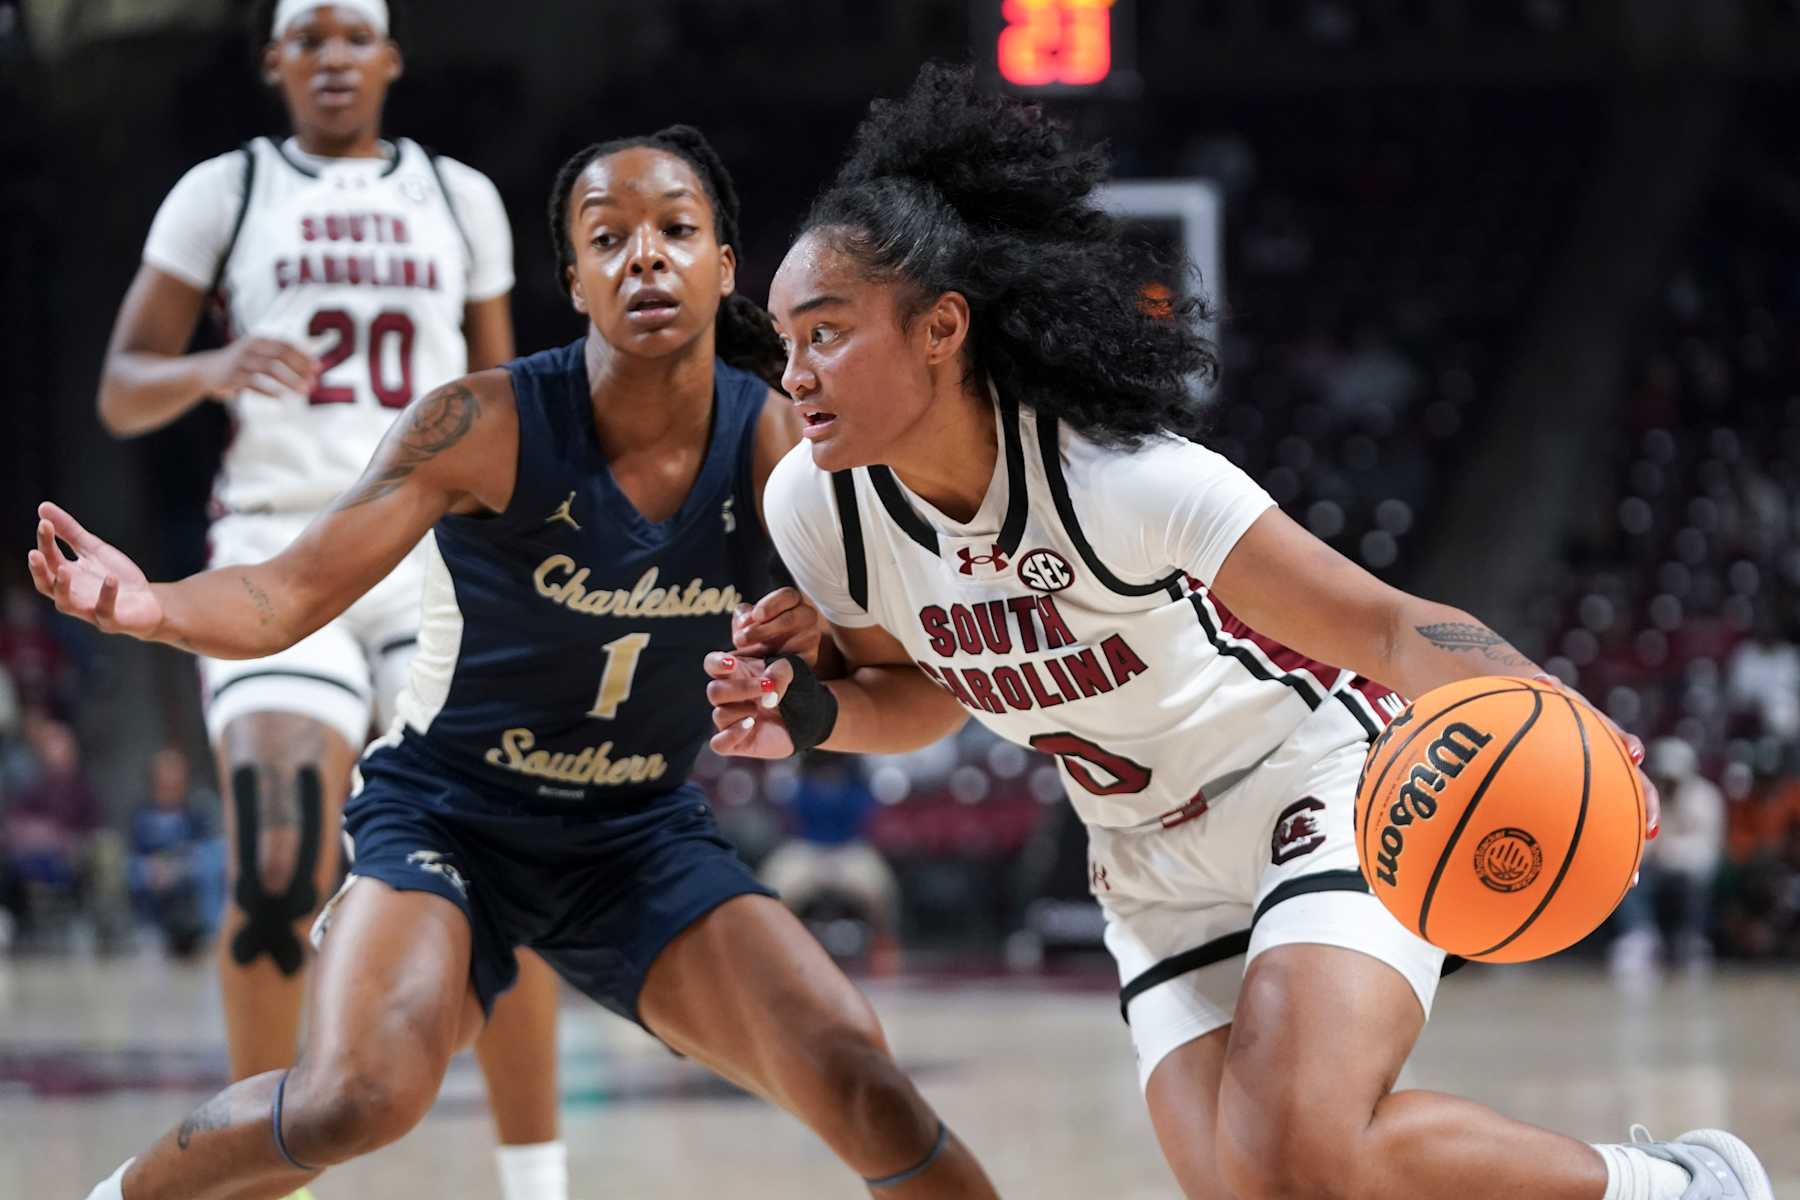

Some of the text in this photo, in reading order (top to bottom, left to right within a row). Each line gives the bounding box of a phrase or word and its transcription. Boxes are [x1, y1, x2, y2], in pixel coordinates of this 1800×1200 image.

[300, 211, 411, 243] SOUTH
[274, 255, 441, 289] CAROLINA
[307, 307, 416, 409] 20
[533, 553, 741, 618] Charleston
[1021, 552, 1071, 590] SEC
[919, 594, 1078, 657] SOUTH
[586, 632, 652, 720] 1
[485, 727, 667, 785] Southern
[1029, 731, 1152, 796] 0
[1376, 721, 1496, 888] Wilson
